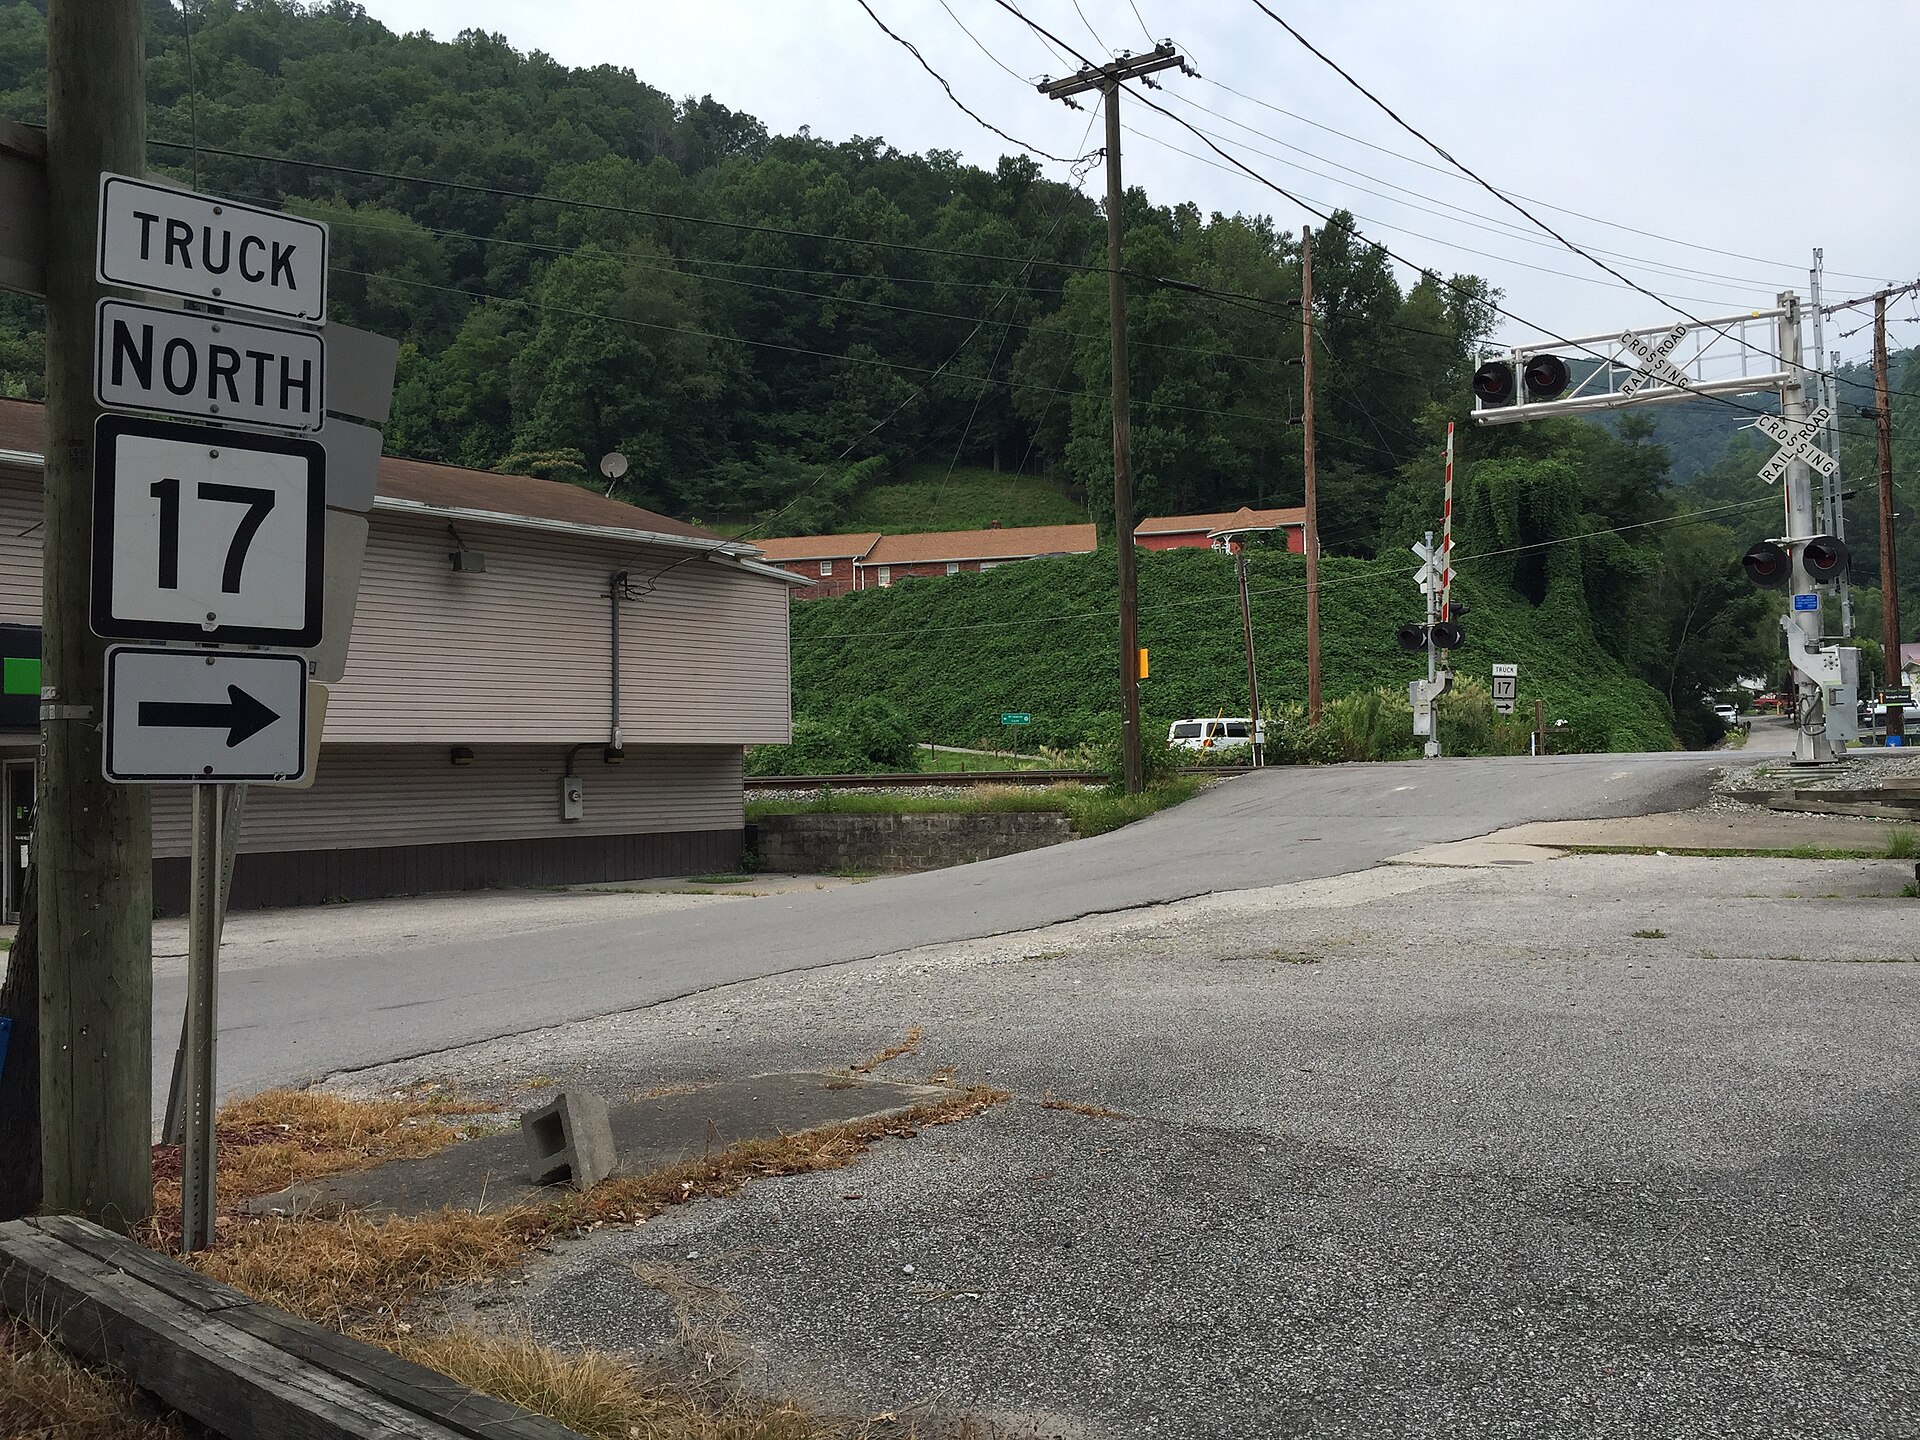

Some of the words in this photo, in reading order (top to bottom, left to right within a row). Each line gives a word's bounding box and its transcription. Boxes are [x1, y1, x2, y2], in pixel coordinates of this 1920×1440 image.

[132, 210, 298, 291] TRUCK
[110, 319, 312, 414] NORTH
[1621, 333, 1689, 388] CROSSING
[1759, 416, 1834, 473] CROSSING
[149, 477, 276, 594] 17
[1497, 681, 1512, 695] 17
